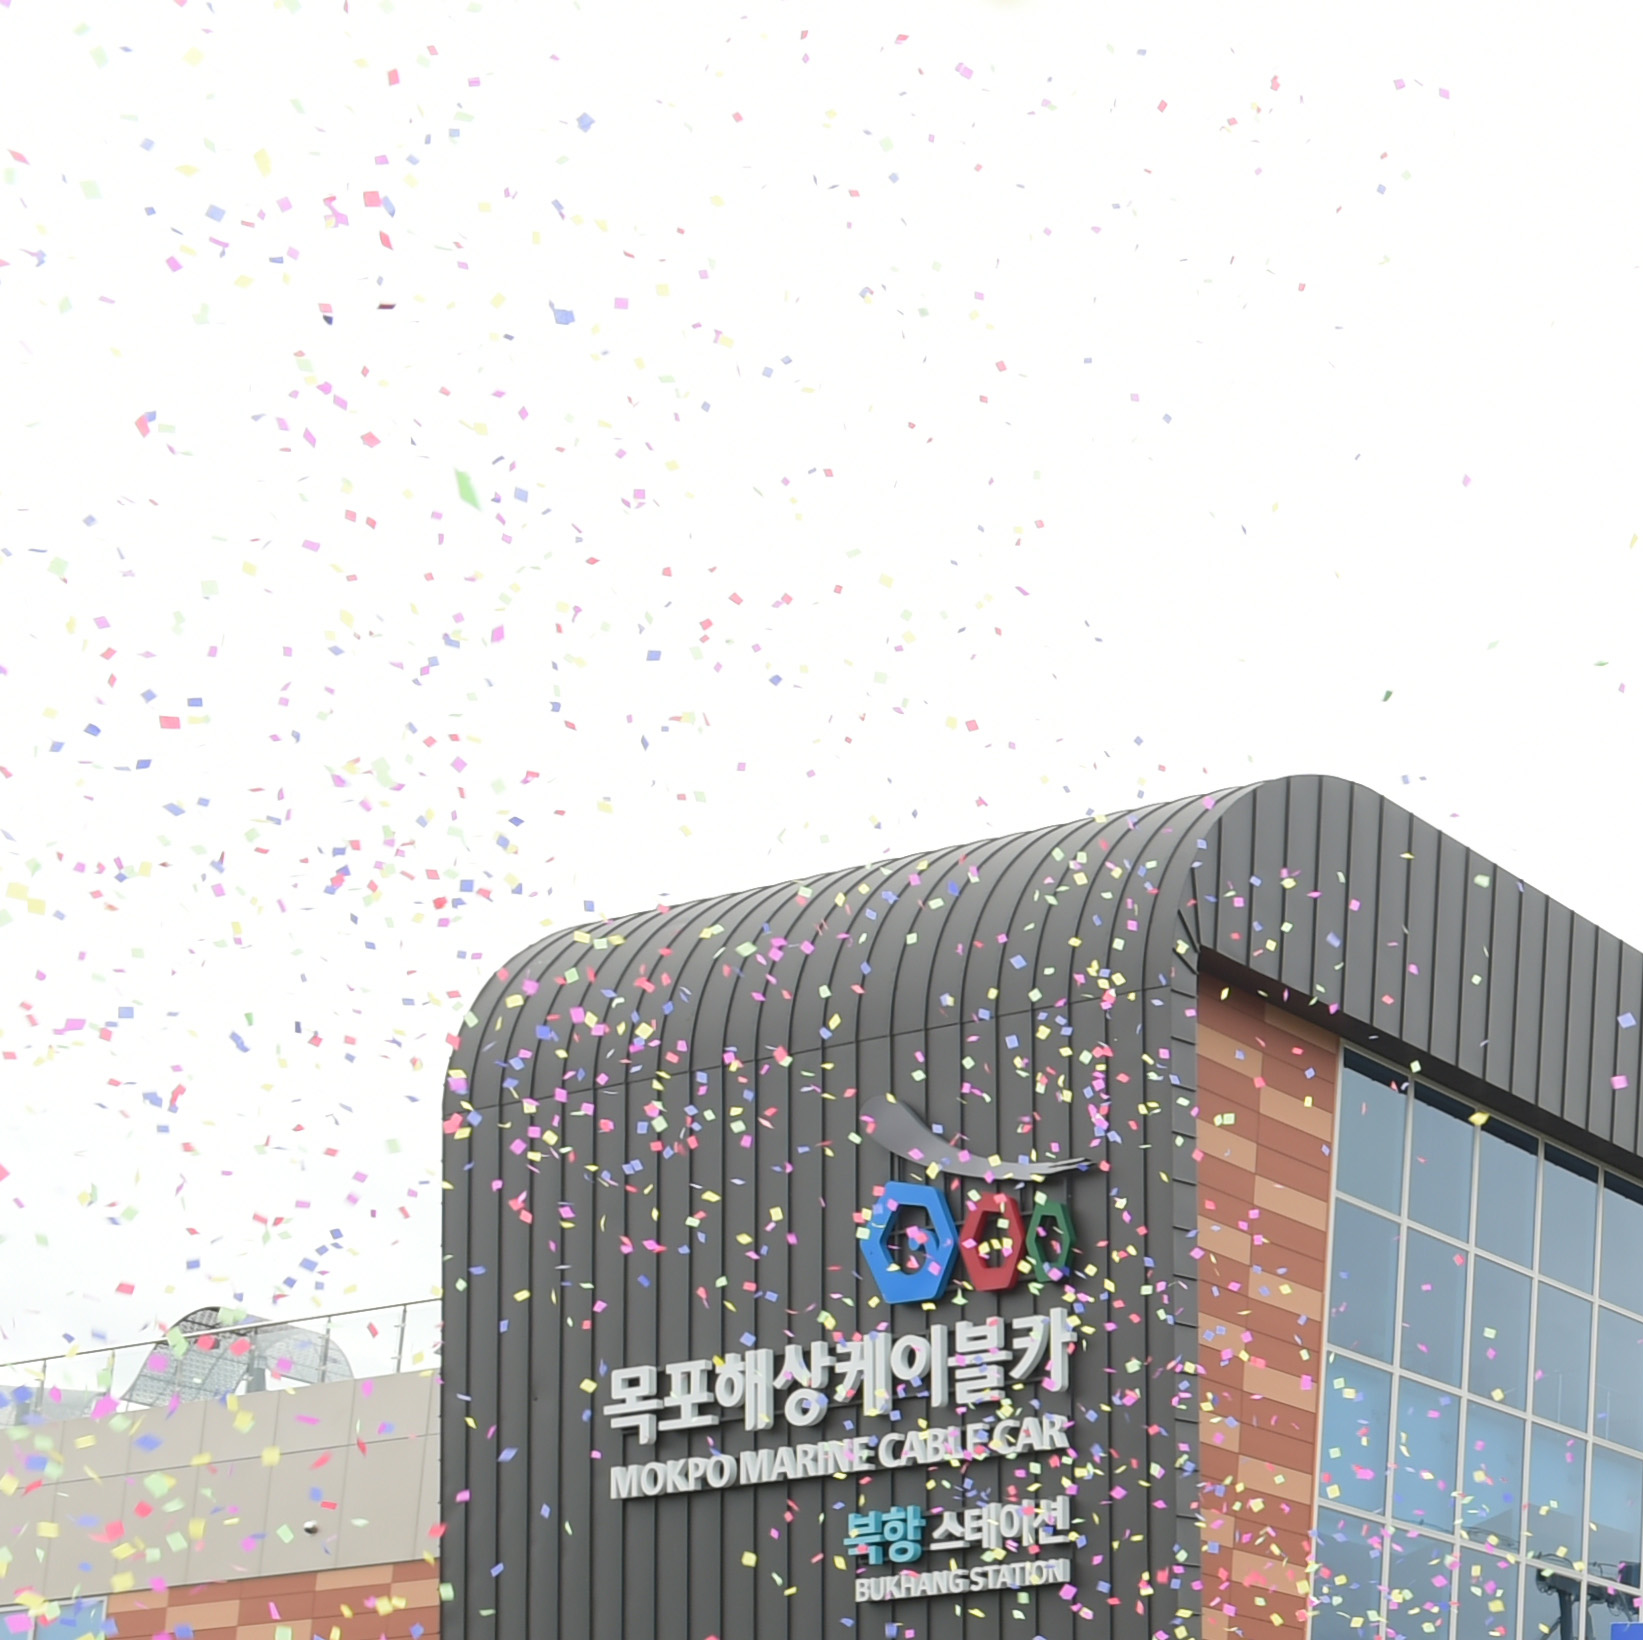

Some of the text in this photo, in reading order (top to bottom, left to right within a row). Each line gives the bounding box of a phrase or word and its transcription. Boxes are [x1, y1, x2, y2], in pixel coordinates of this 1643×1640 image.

[604, 1307, 1077, 1444] 목포해상케이블카
[609, 1415, 1070, 1499] MOKPO MARINE CABLE CAR
[844, 1495, 1072, 1564] 북항 스테이션
[855, 1557, 1070, 1602] BUKHANG STATION
